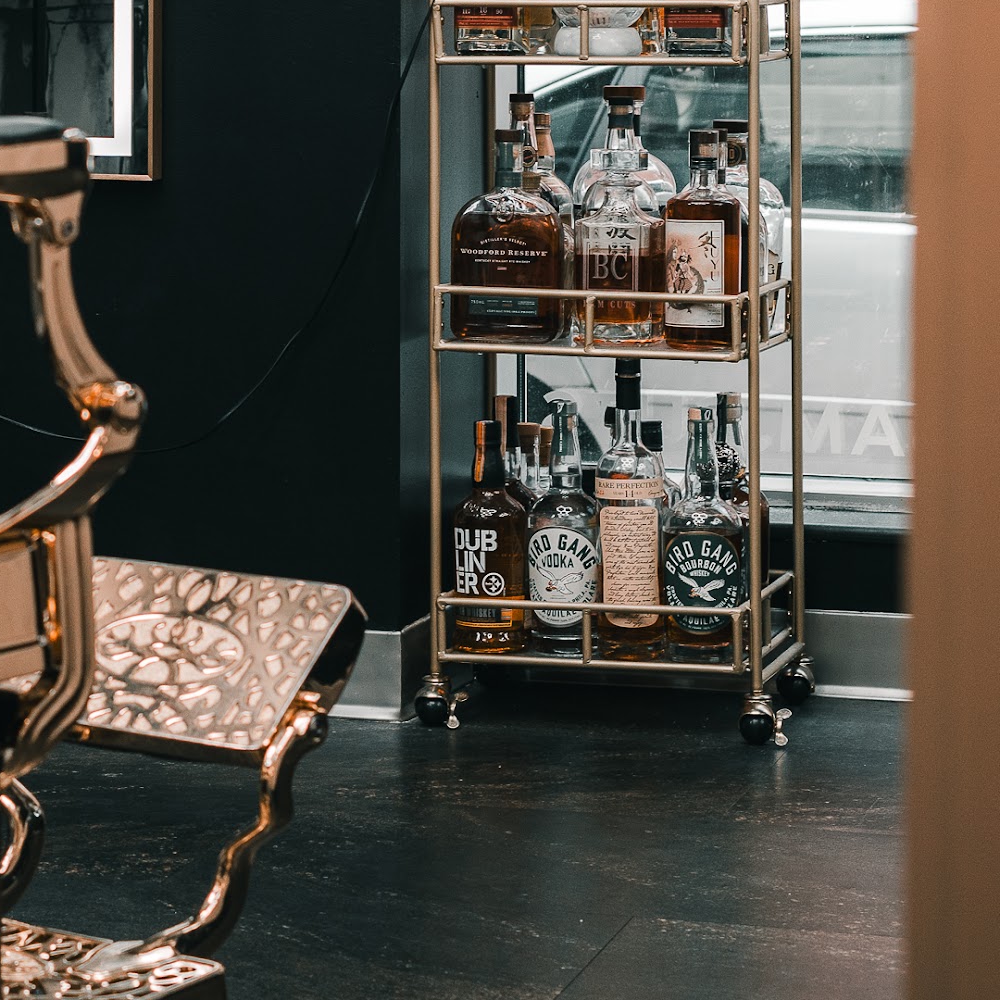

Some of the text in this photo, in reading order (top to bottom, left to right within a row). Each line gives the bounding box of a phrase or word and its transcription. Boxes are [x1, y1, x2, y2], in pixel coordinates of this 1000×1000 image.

[460, 248, 548, 257] WOODFORD RESERVE
[592, 252, 628, 280] BC
[610, 300, 636, 309] CUTS
[598, 480, 659, 489] RARE PERFECTION
[454, 527, 498, 552] DUB
[528, 533, 597, 570] BIRD GANG
[455, 549, 486, 574] LIN
[541, 553, 575, 568] VODKA
[665, 539, 738, 576] BIRD GANG
[679, 558, 723, 575] BOURBON
[456, 571, 480, 595] ER
